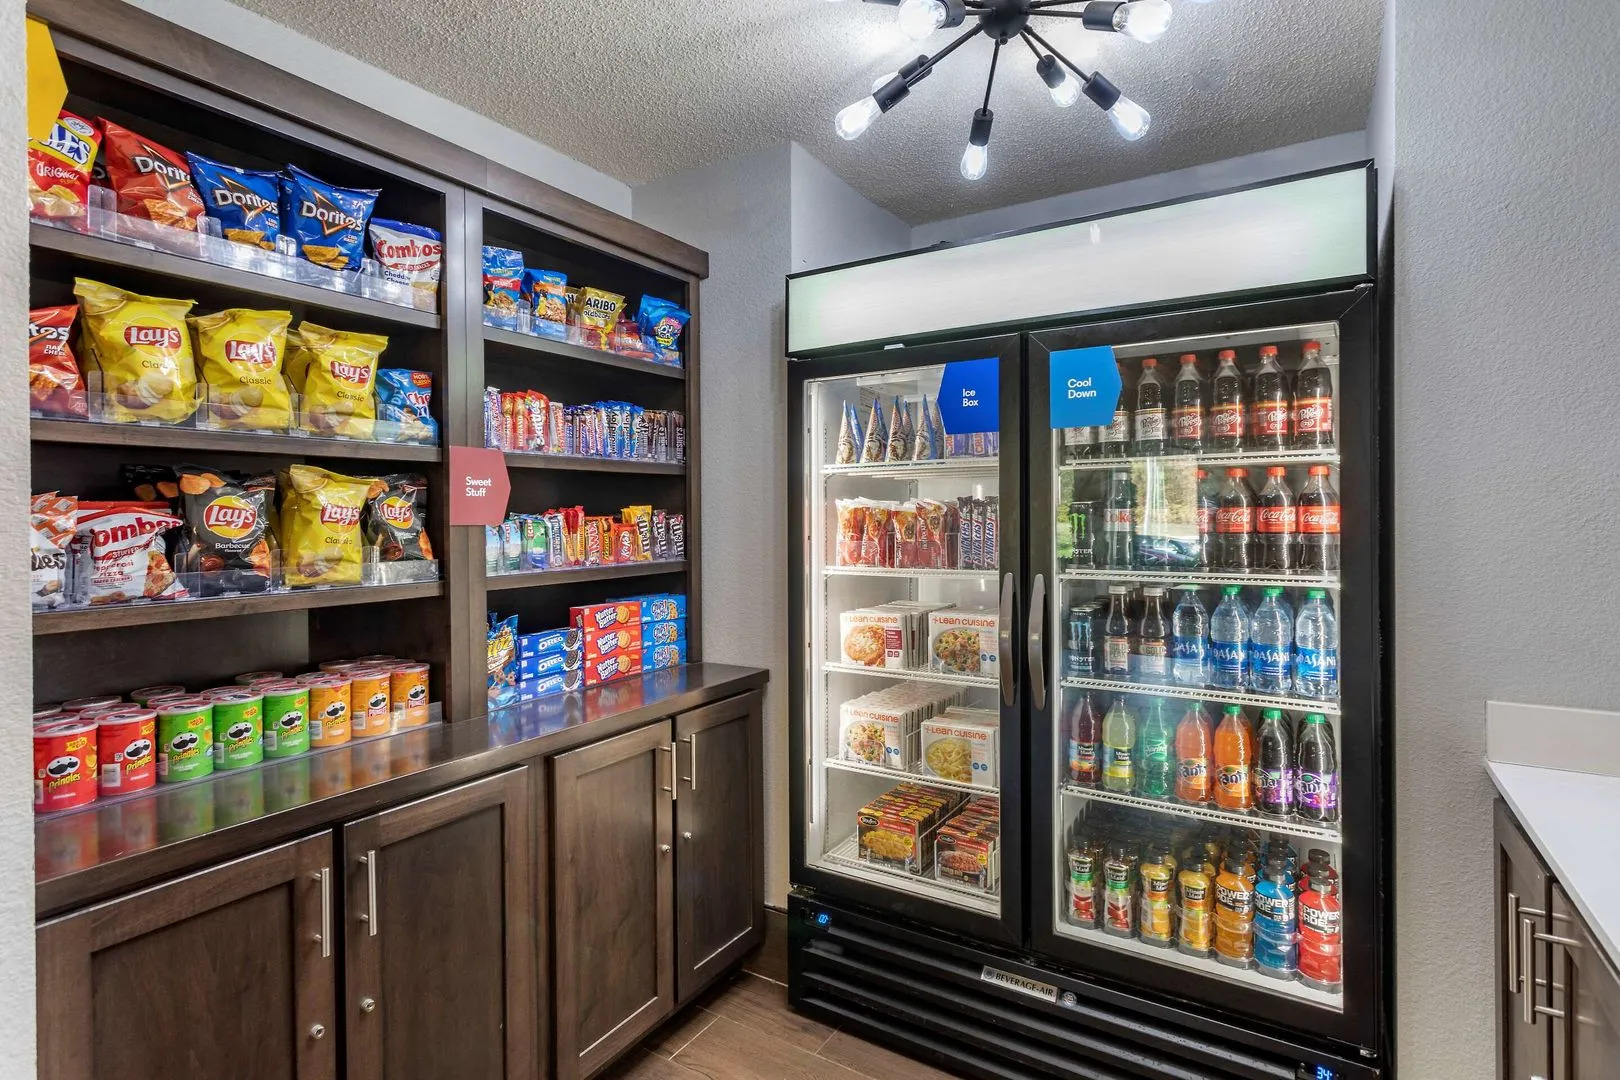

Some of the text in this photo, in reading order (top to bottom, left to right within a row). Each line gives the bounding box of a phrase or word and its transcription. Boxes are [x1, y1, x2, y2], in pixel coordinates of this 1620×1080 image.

[134, 156, 191, 182] Dorit
[215, 189, 279, 214] Doritos
[302, 201, 363, 232] Doritos
[376, 239, 442, 260] Combos
[586, 297, 616, 312] ARIBO
[583, 310, 611, 320] oldbears
[130, 326, 180, 349] Lay's
[230, 339, 276, 364] Lay's
[334, 360, 371, 384] Lay's
[1067, 377, 1092, 389] Cool
[407, 390, 431, 405] Che
[962, 388, 976, 398] Ice
[1068, 389, 1097, 399] Down
[962, 398, 979, 407] Box
[975, 432, 984, 454] CRU
[465, 476, 492, 486] Sweet
[465, 487, 487, 497] Stuff
[208, 505, 254, 529] Lay's
[323, 502, 360, 527] Lay's
[383, 503, 412, 522] Lay's
[961, 520, 971, 561] SNICKERS
[972, 523, 983, 565] SNICKERS
[985, 520, 995, 562] SNICKERS
[595, 606, 615, 622] Nutter
[599, 612, 617, 629] Butter
[538, 636, 563, 651] OREO
[597, 631, 616, 646] Nutter
[600, 637, 619, 655] Butter
[1175, 642, 1204, 656] DASA
[1213, 646, 1245, 662] DASAN
[1253, 649, 1290, 664] DASANI
[538, 656, 563, 671] OREO
[597, 656, 617, 672] Nutter
[1295, 652, 1336, 667] DASANI
[600, 661, 619, 680] Butter
[538, 676, 562, 692] OREO
[126, 754, 153, 776] Pringles
[172, 747, 200, 766] Pringles
[48, 772, 81, 794] Pringles
[1258, 776, 1277, 789] nta
[1299, 780, 1330, 795] anta
[1216, 884, 1250, 900] POWER
[1255, 891, 1289, 908] POWER
[1303, 904, 1340, 921] POWER
[995, 972, 1054, 998] BEVERAGE-AIR
